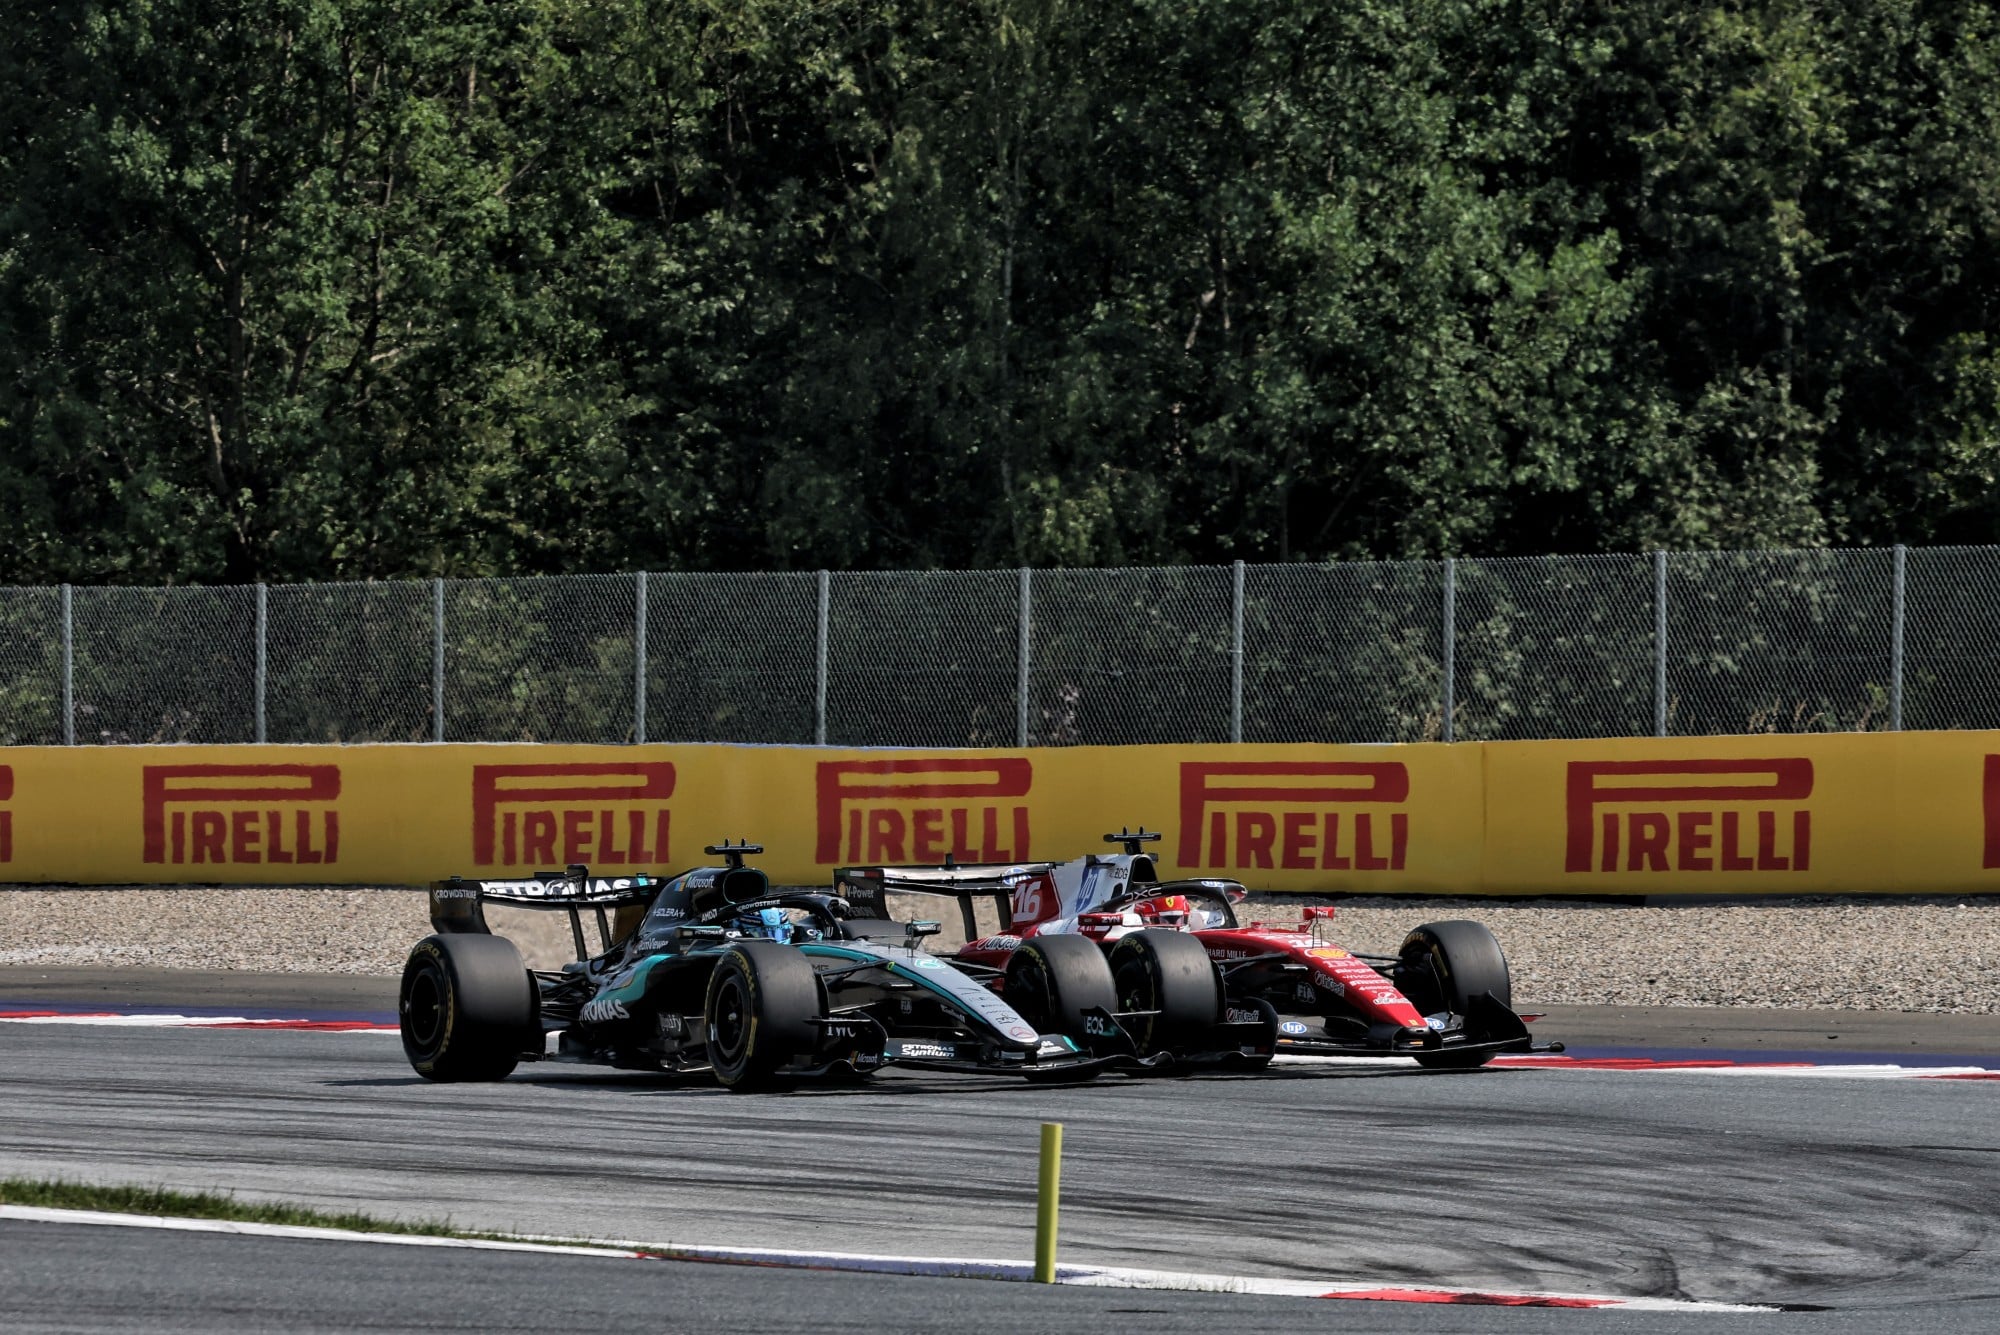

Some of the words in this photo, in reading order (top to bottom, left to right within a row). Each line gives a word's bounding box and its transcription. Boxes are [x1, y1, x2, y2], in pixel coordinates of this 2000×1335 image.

[143, 765, 341, 864] PIRELLI
[473, 762, 675, 865] PIRELLI
[816, 758, 1032, 866] PIRELLI
[1178, 761, 1408, 870] PIRELLI
[1566, 758, 1813, 872] PIRELLI
[686, 875, 715, 888] Microsoft
[1013, 881, 1042, 922] 16
[1201, 949, 1225, 958] HARD
[1081, 1013, 1105, 1035] EOS
